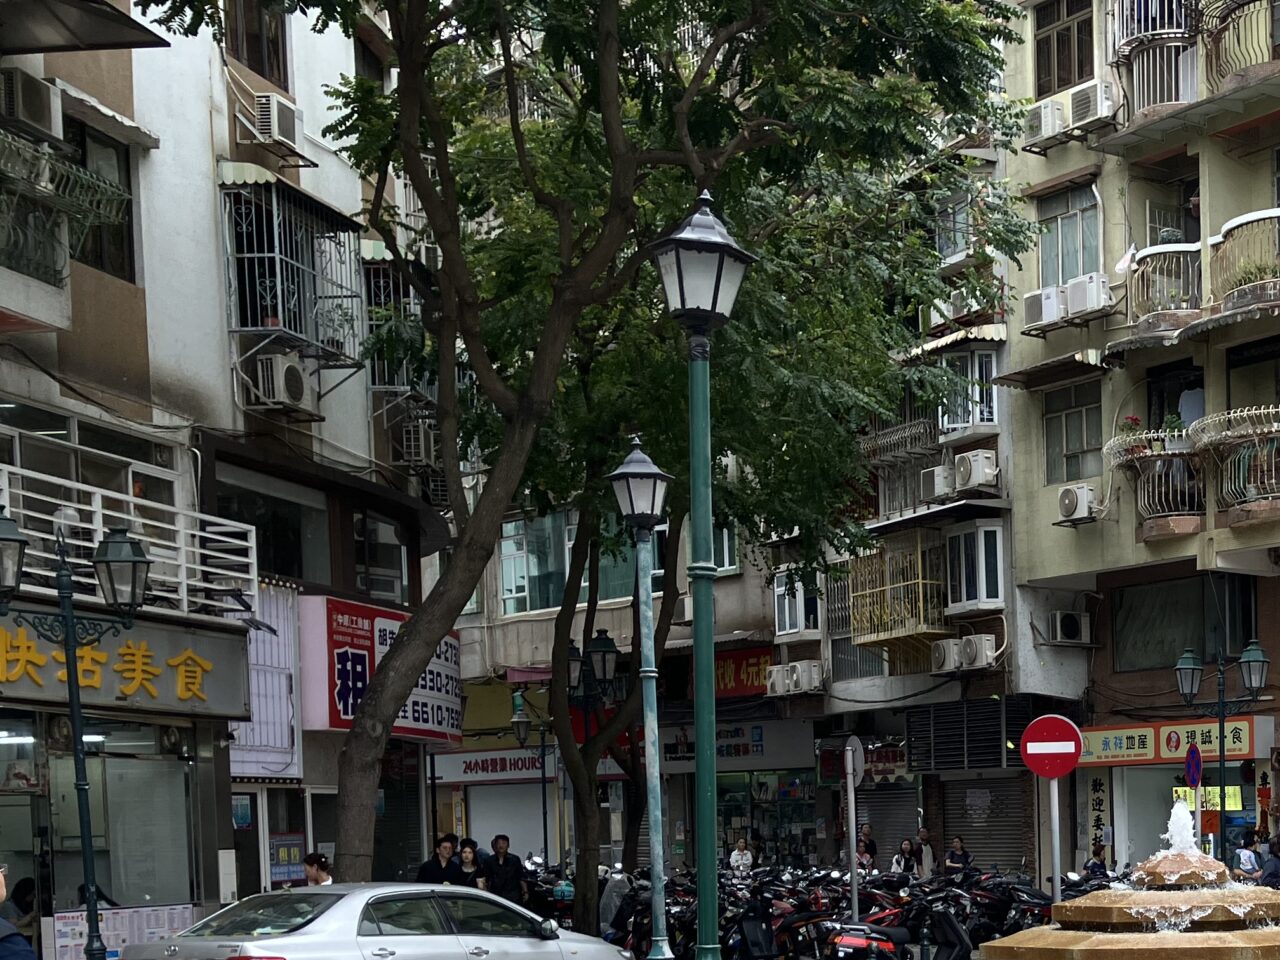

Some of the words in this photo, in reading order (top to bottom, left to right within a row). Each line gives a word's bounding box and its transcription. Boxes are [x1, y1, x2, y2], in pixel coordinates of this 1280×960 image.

[0, 626, 214, 701] 快活美食
[335, 648, 369, 717] 租
[508, 755, 544, 772] HOURS
